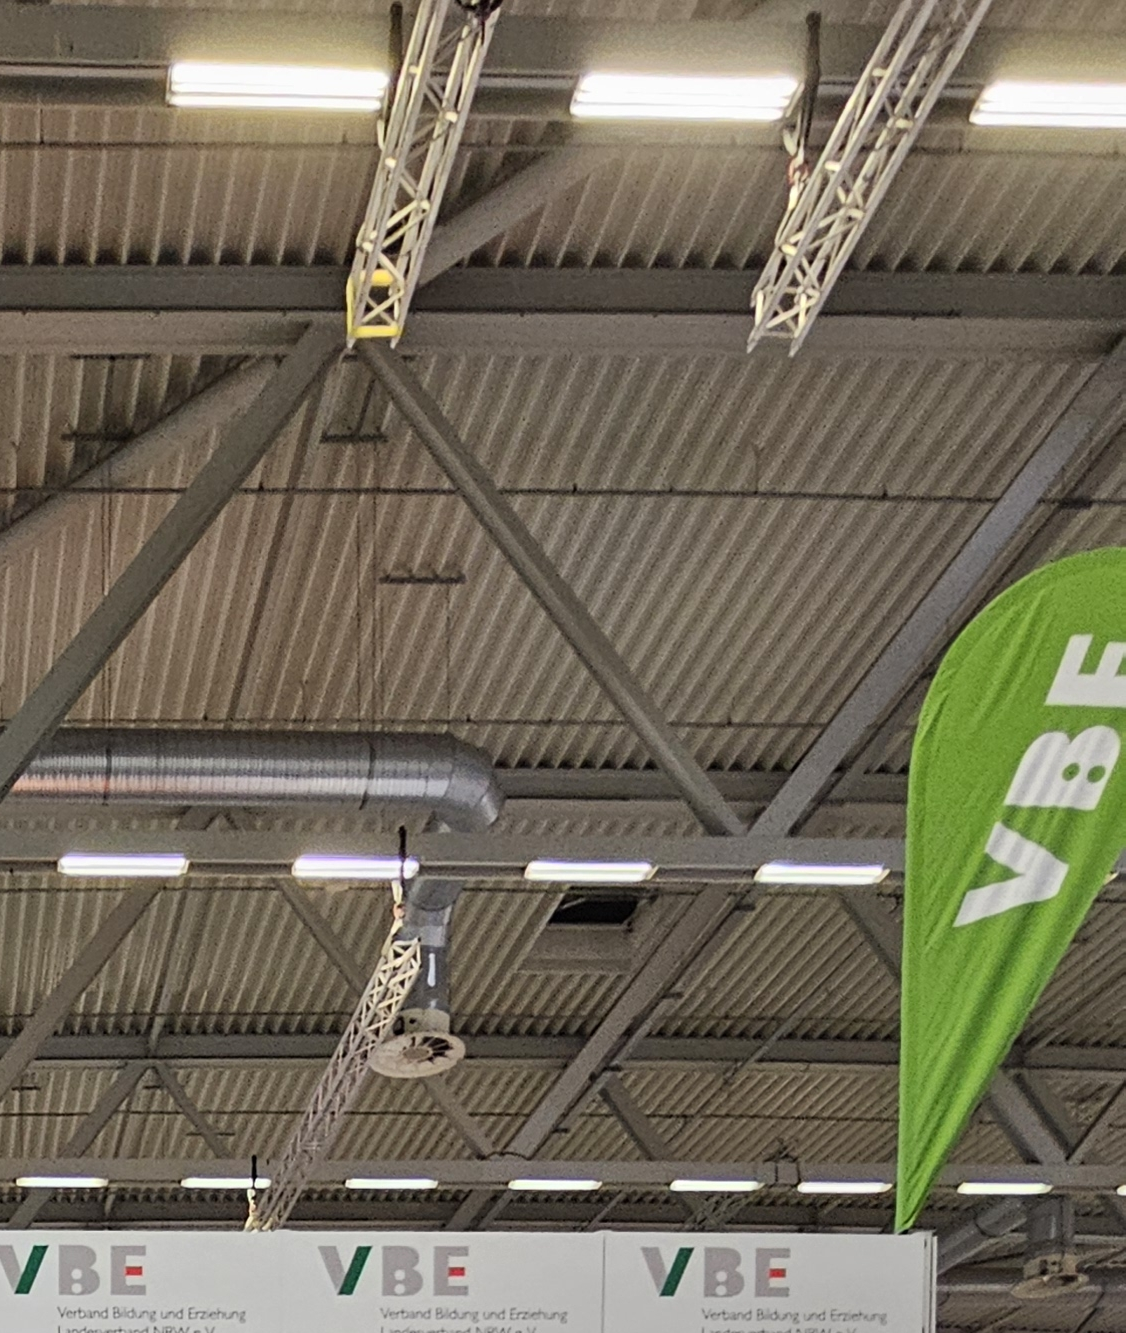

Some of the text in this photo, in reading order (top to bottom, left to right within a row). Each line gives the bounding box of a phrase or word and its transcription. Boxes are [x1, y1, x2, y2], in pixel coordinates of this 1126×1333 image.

[953, 634, 1126, 927] VBE
[317, 1246, 469, 1296] VBE
[640, 1247, 791, 1298] VBE
[57, 1306, 246, 1323] Verband Bildung und Erziehung
[380, 1307, 568, 1324] Verband Bildung und Erziehung
[702, 1308, 887, 1324] Verband Bildung und Erziehung
